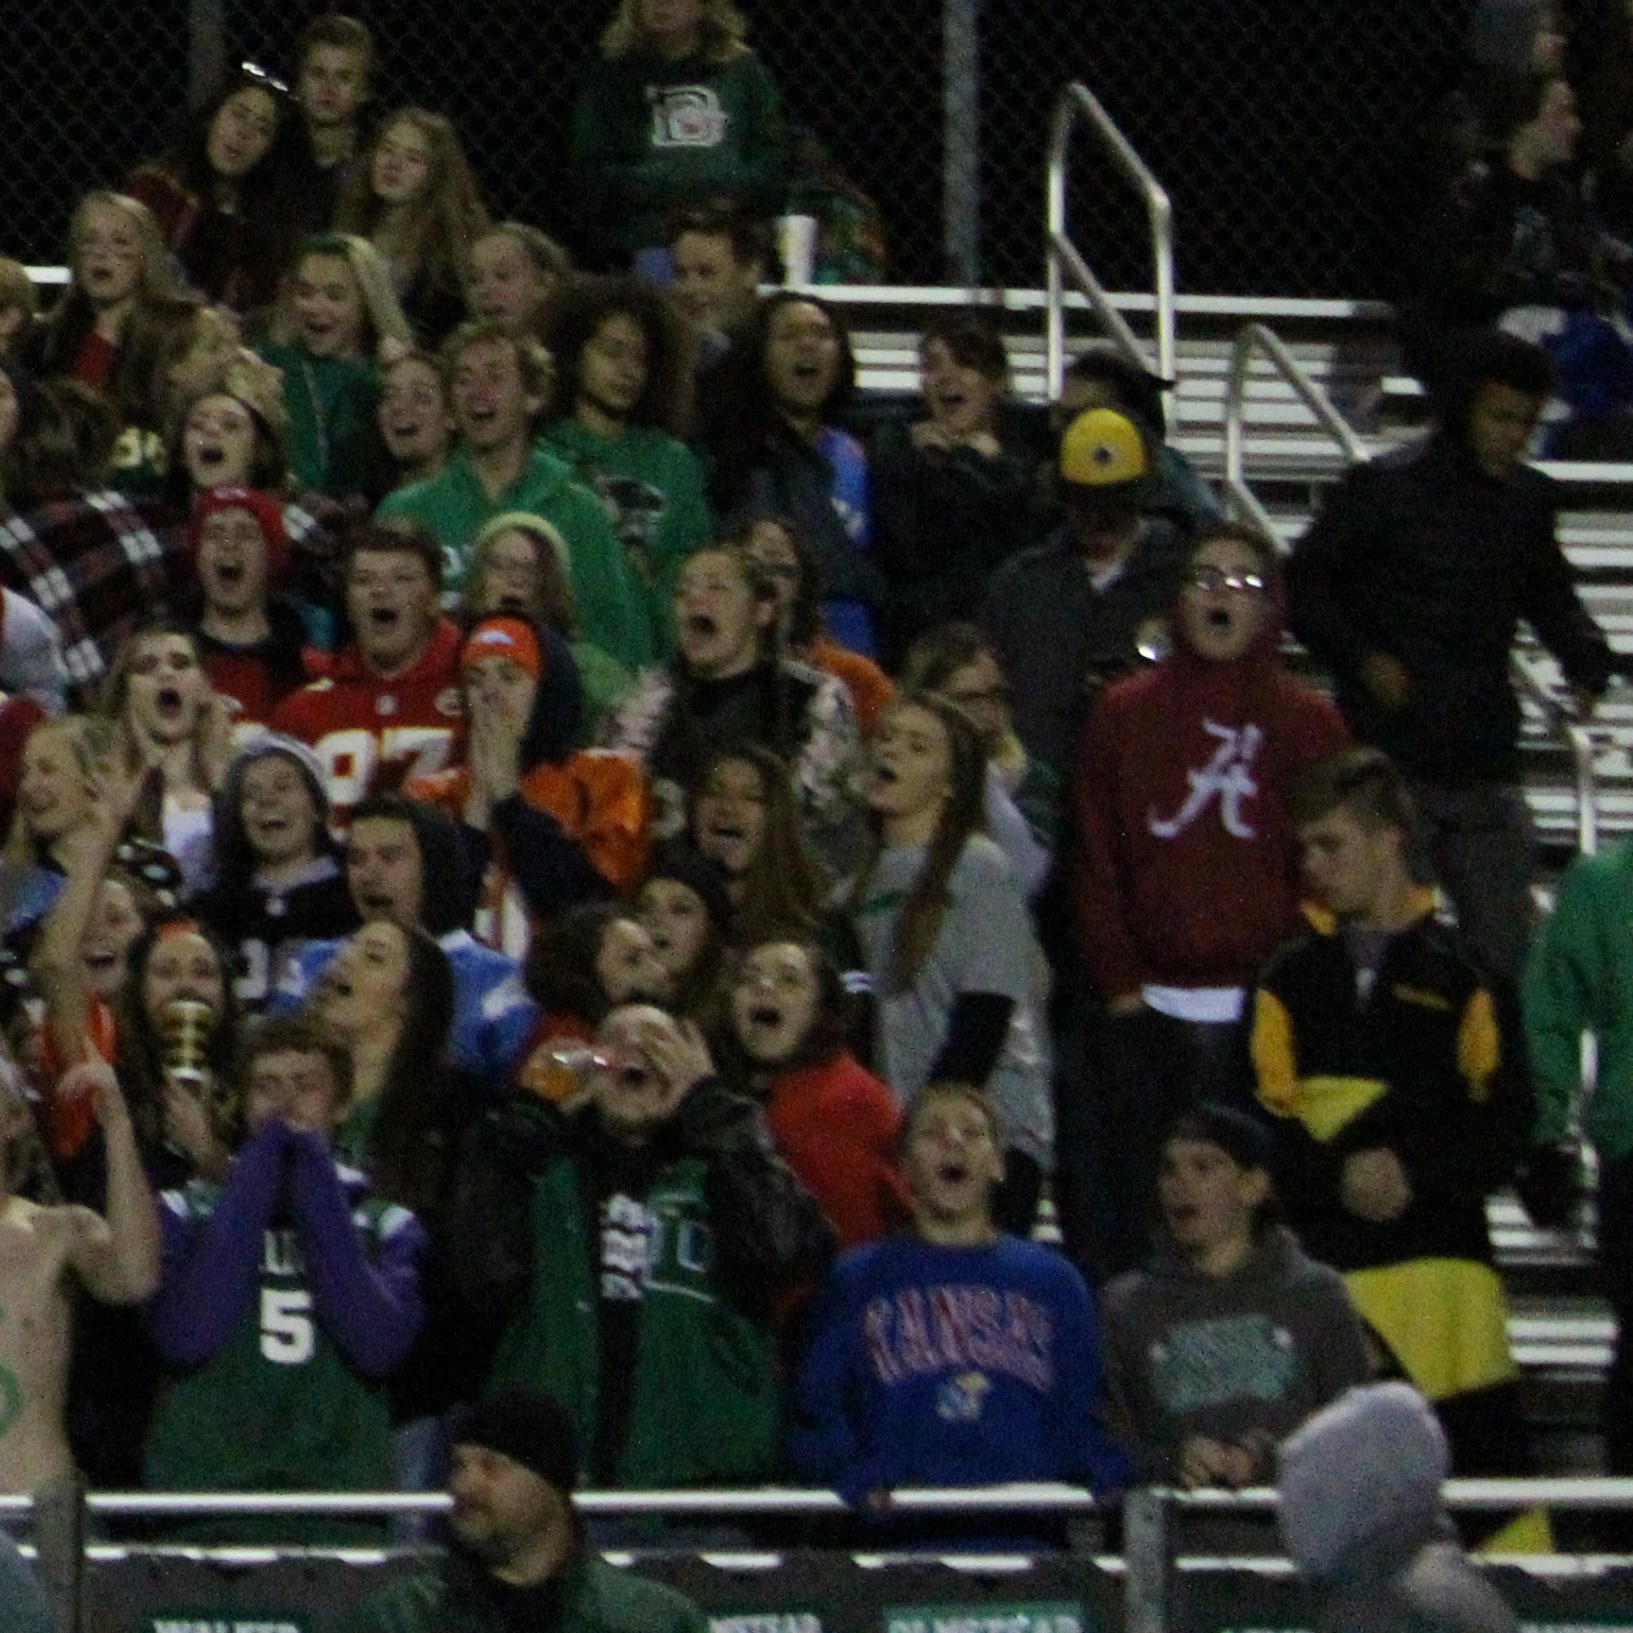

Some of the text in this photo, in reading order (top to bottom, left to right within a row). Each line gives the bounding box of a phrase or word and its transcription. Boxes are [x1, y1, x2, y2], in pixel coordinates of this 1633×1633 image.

[1147, 718, 1260, 838] A
[259, 1287, 316, 1367] 5
[863, 1282, 1053, 1394] KANSAS
